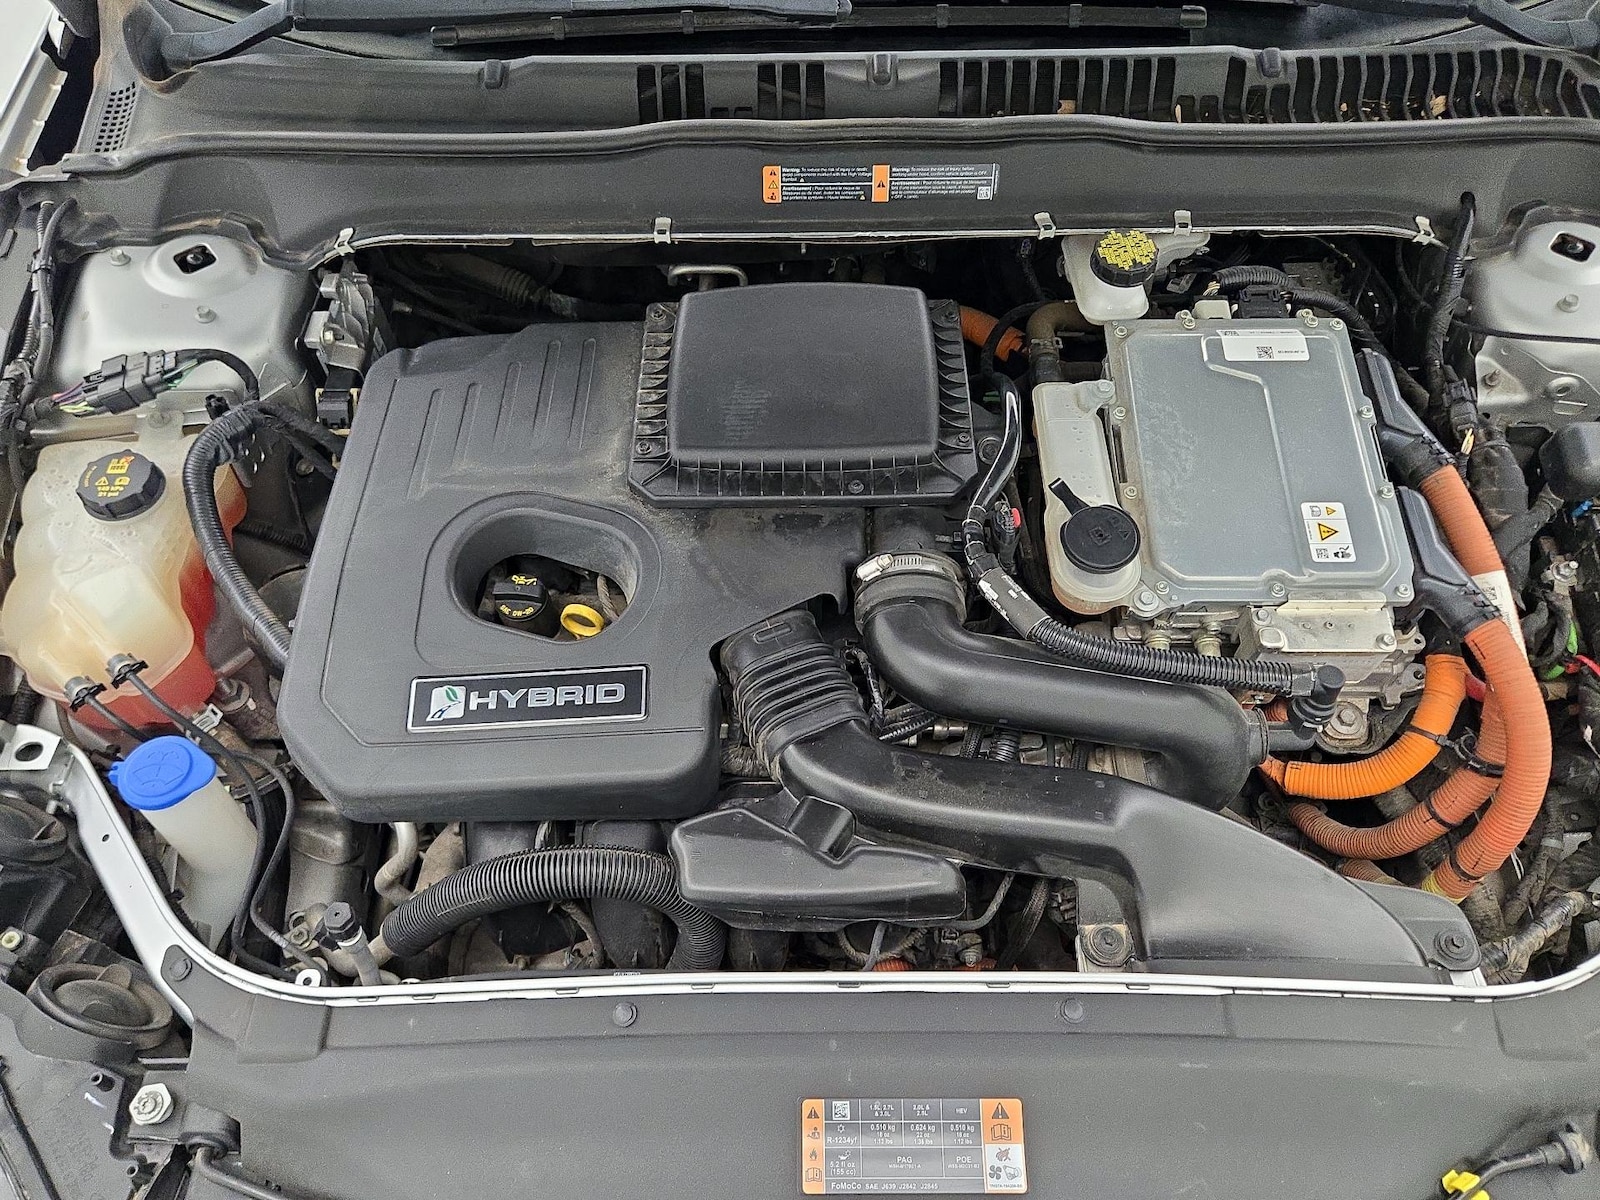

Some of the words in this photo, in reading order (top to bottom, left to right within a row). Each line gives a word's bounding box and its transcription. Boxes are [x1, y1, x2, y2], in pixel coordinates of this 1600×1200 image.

[500, 604, 512, 616] SAE
[512, 606, 534, 617] 0W-20
[468, 683, 626, 711] HYBRID
[888, 1124, 896, 1132] kg
[928, 1124, 936, 1132] kg
[967, 1124, 974, 1132] kg
[826, 1136, 858, 1145] R-1234yf
[831, 1182, 862, 1190] FoMoCo
